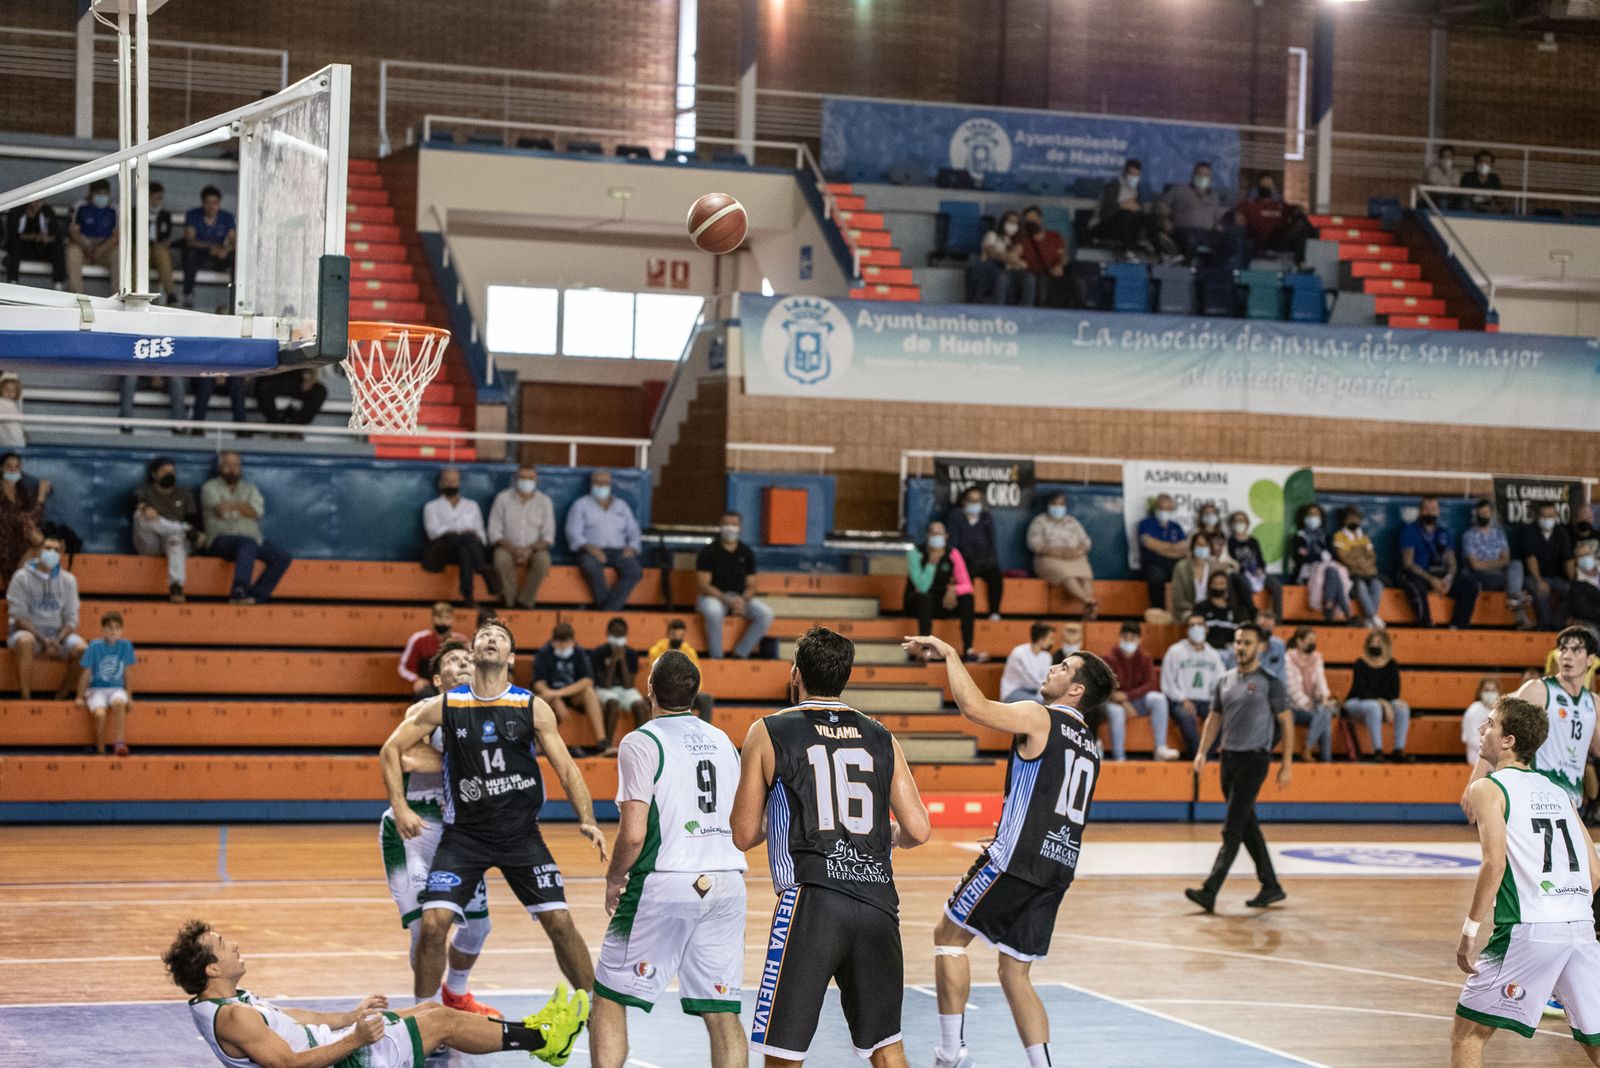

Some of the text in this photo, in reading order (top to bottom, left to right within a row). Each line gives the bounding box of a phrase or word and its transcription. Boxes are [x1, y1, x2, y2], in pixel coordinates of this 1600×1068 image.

[1014, 129, 1128, 152] Ayuntamiento
[1046, 148, 1126, 166] de Huelva
[857, 309, 1018, 335] Ayuntamiento
[133, 336, 175, 360] GES
[903, 335, 1019, 357] de Huelva
[1072, 319, 1114, 347] La
[1121, 321, 1227, 351] emoción
[1235, 323, 1263, 353] de
[1419, 343, 1450, 364] ser
[814, 724, 862, 740] VILLAMIL
[1571, 719, 1583, 740] 13
[481, 748, 506, 774] 14
[696, 759, 717, 814] 9
[806, 744, 874, 835] 16
[1054, 748, 1094, 826] 10
[1530, 817, 1580, 873] 71
[771, 886, 797, 950] UELVA
[752, 959, 780, 1034] HUELVA
